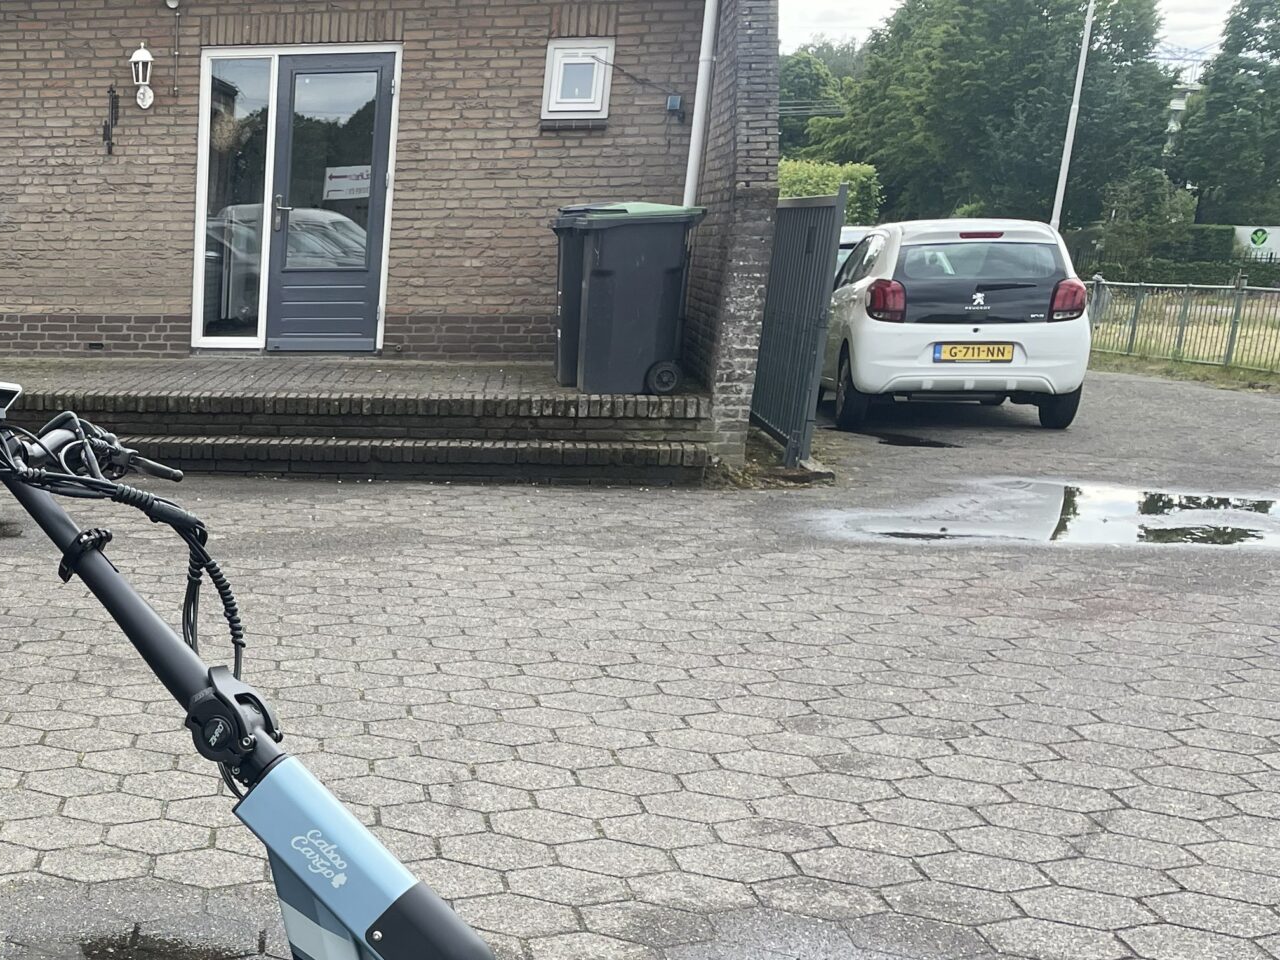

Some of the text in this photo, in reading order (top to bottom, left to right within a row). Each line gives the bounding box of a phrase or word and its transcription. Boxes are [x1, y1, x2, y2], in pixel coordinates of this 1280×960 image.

[949, 346, 1006, 358] G-711-NN
[291, 836, 336, 880] Cargo
[306, 829, 348, 869] Caboo
